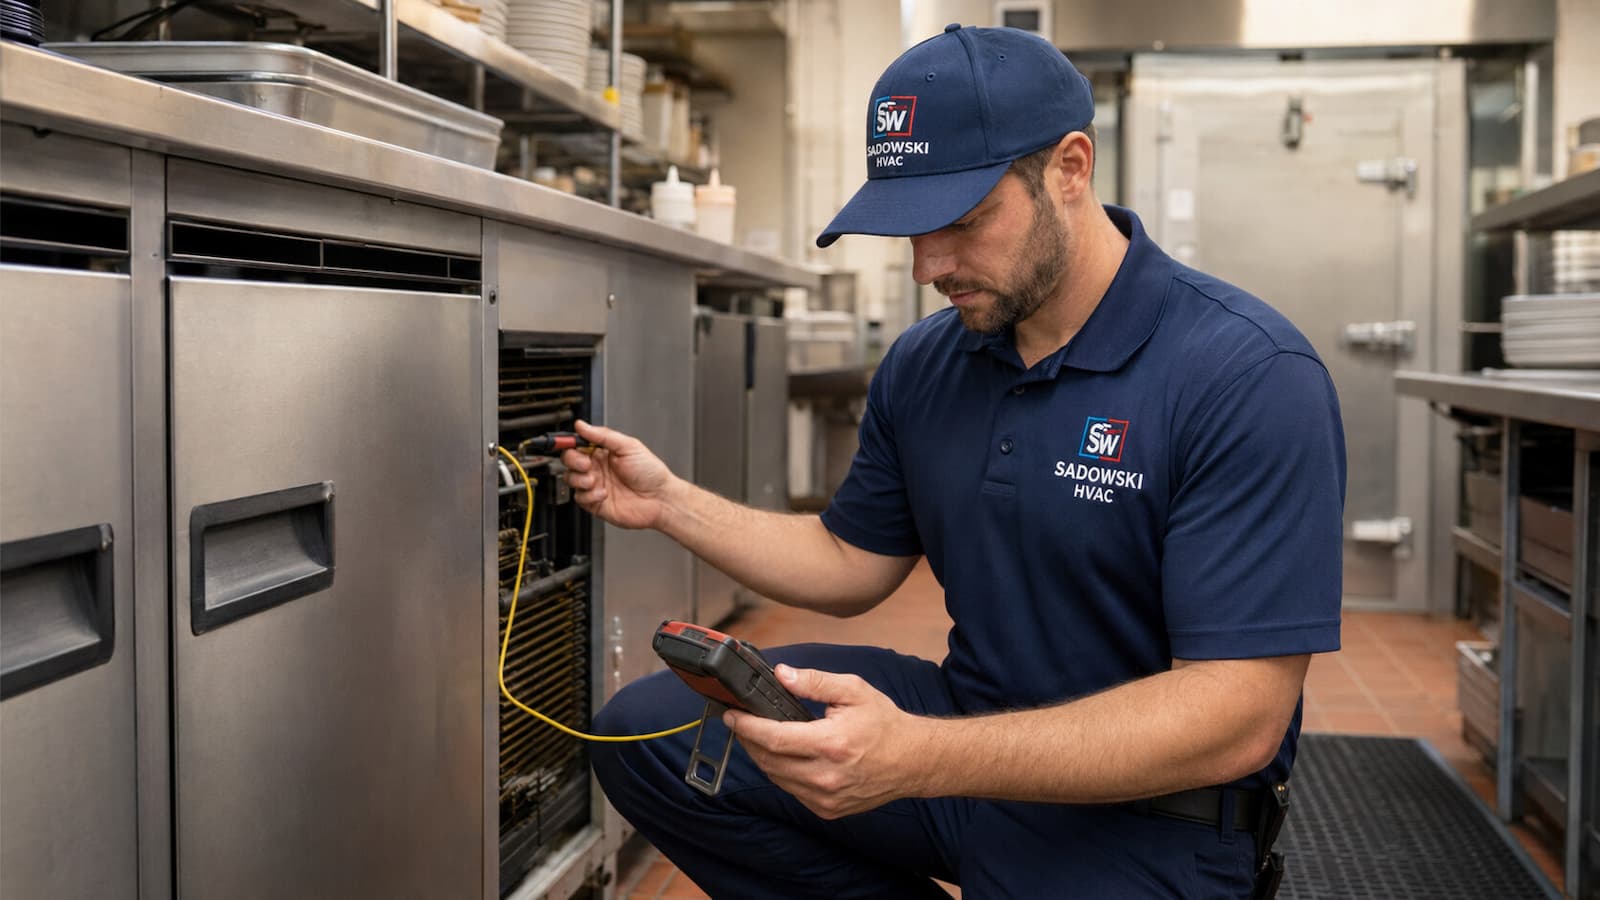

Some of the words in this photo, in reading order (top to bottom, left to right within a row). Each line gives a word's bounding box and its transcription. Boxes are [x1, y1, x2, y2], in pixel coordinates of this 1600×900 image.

[867, 142, 929, 157] SADOWSKI
[876, 156, 904, 167] HVAC
[1054, 461, 1143, 490] SADOWSKI
[1073, 484, 1114, 503] HVAC
